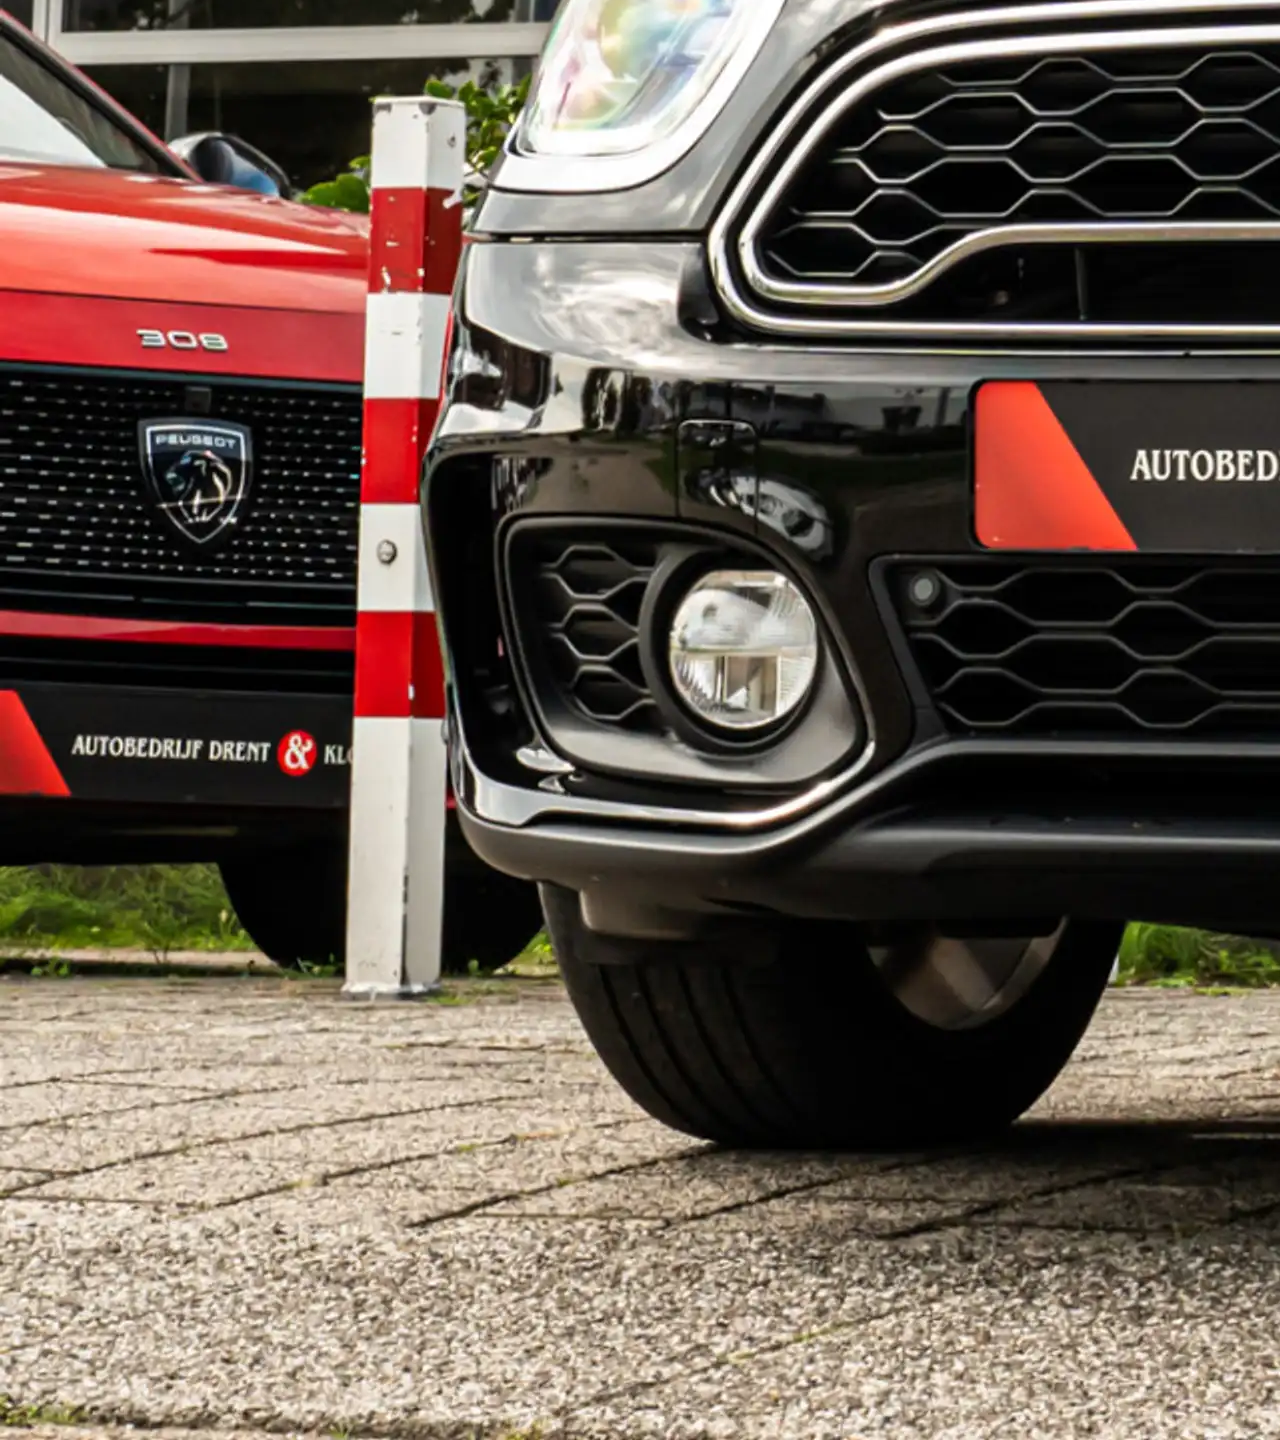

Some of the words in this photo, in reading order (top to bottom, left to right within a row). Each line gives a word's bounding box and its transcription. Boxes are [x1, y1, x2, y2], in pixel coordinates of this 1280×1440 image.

[136, 328, 229, 351] 308
[155, 433, 237, 449] PEUGEOT
[71, 733, 203, 760] AUTOBEDRIJF
[208, 740, 271, 763] DRENT
[284, 734, 312, 770] &
